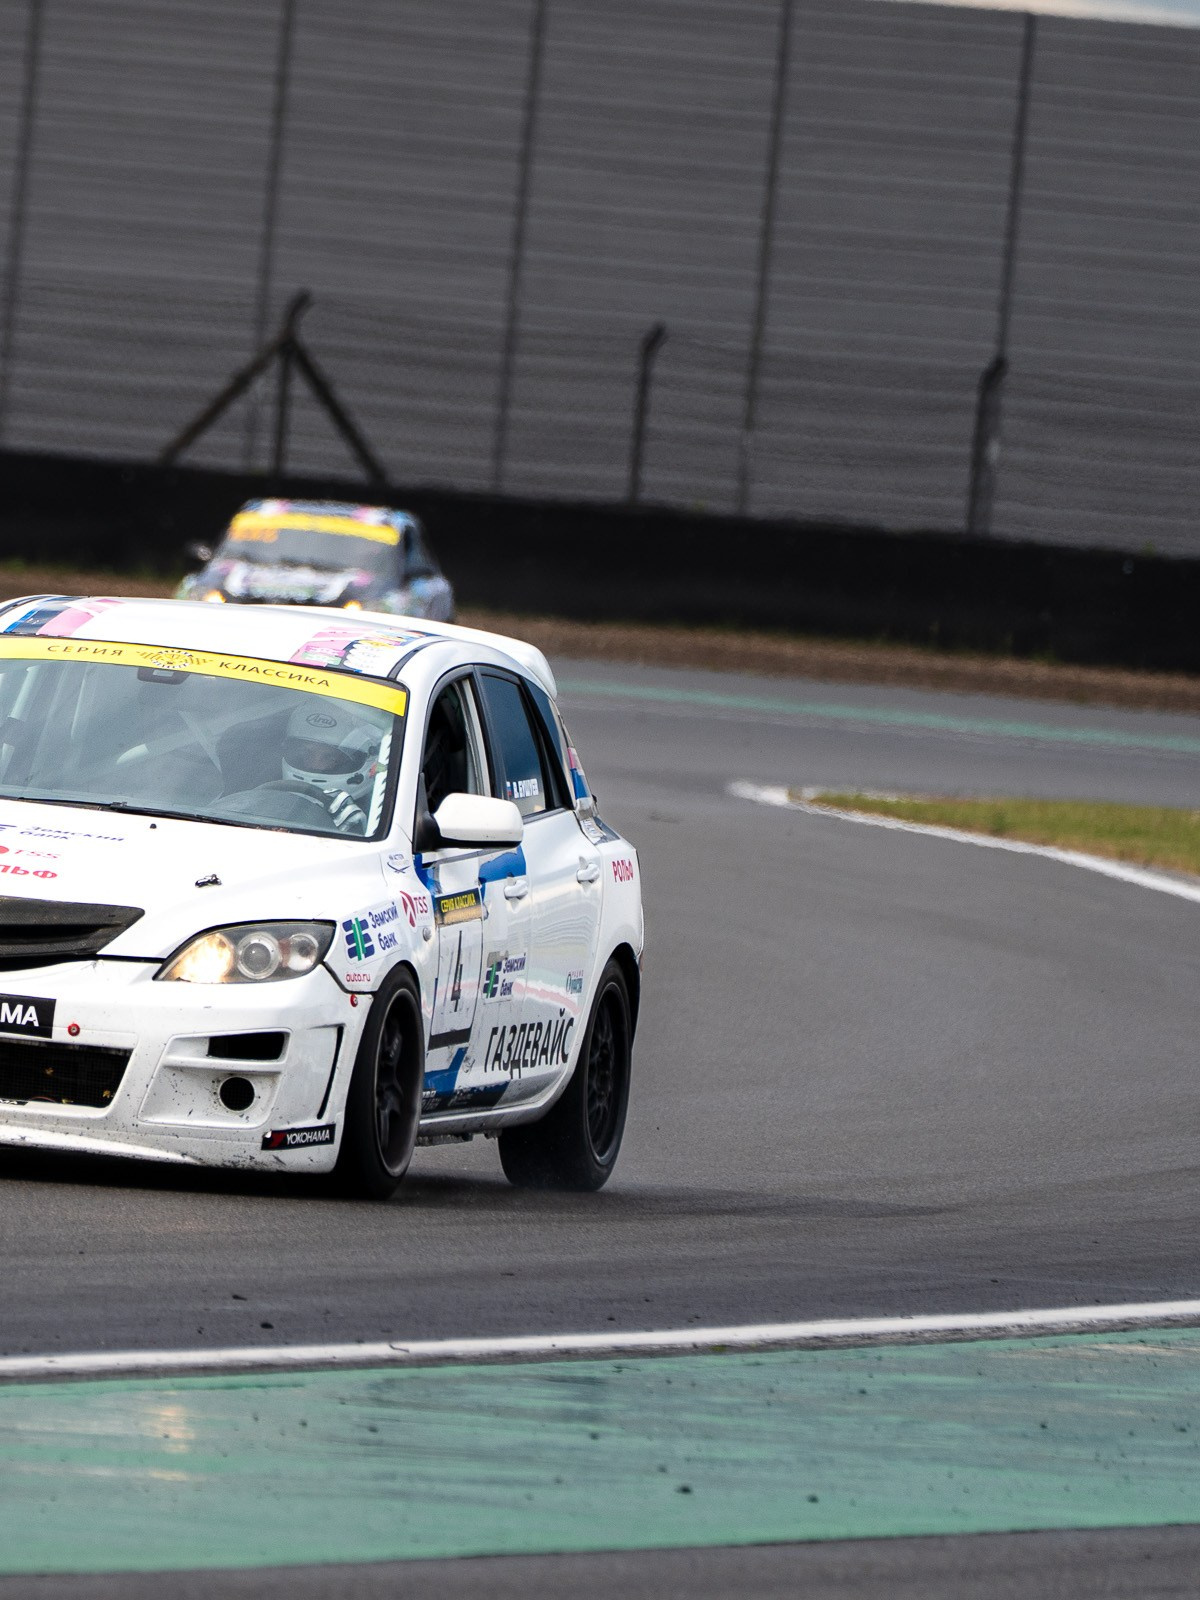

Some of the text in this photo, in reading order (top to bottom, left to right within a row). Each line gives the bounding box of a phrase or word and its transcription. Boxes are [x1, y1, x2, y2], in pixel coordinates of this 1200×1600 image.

[46, 645, 331, 687] СЕРИЯ КЛАССИКА
[612, 860, 634, 883] РОЛЬФ
[368, 901, 400, 929] Земский
[413, 896, 429, 914] TSS
[377, 931, 399, 951] банк
[502, 953, 527, 975] Земский
[345, 971, 372, 983] auto.ru
[499, 978, 514, 997] банк
[483, 1008, 576, 1081] ГАЗДЕВАЙС
[286, 1128, 331, 1146] YOKOHAMA
